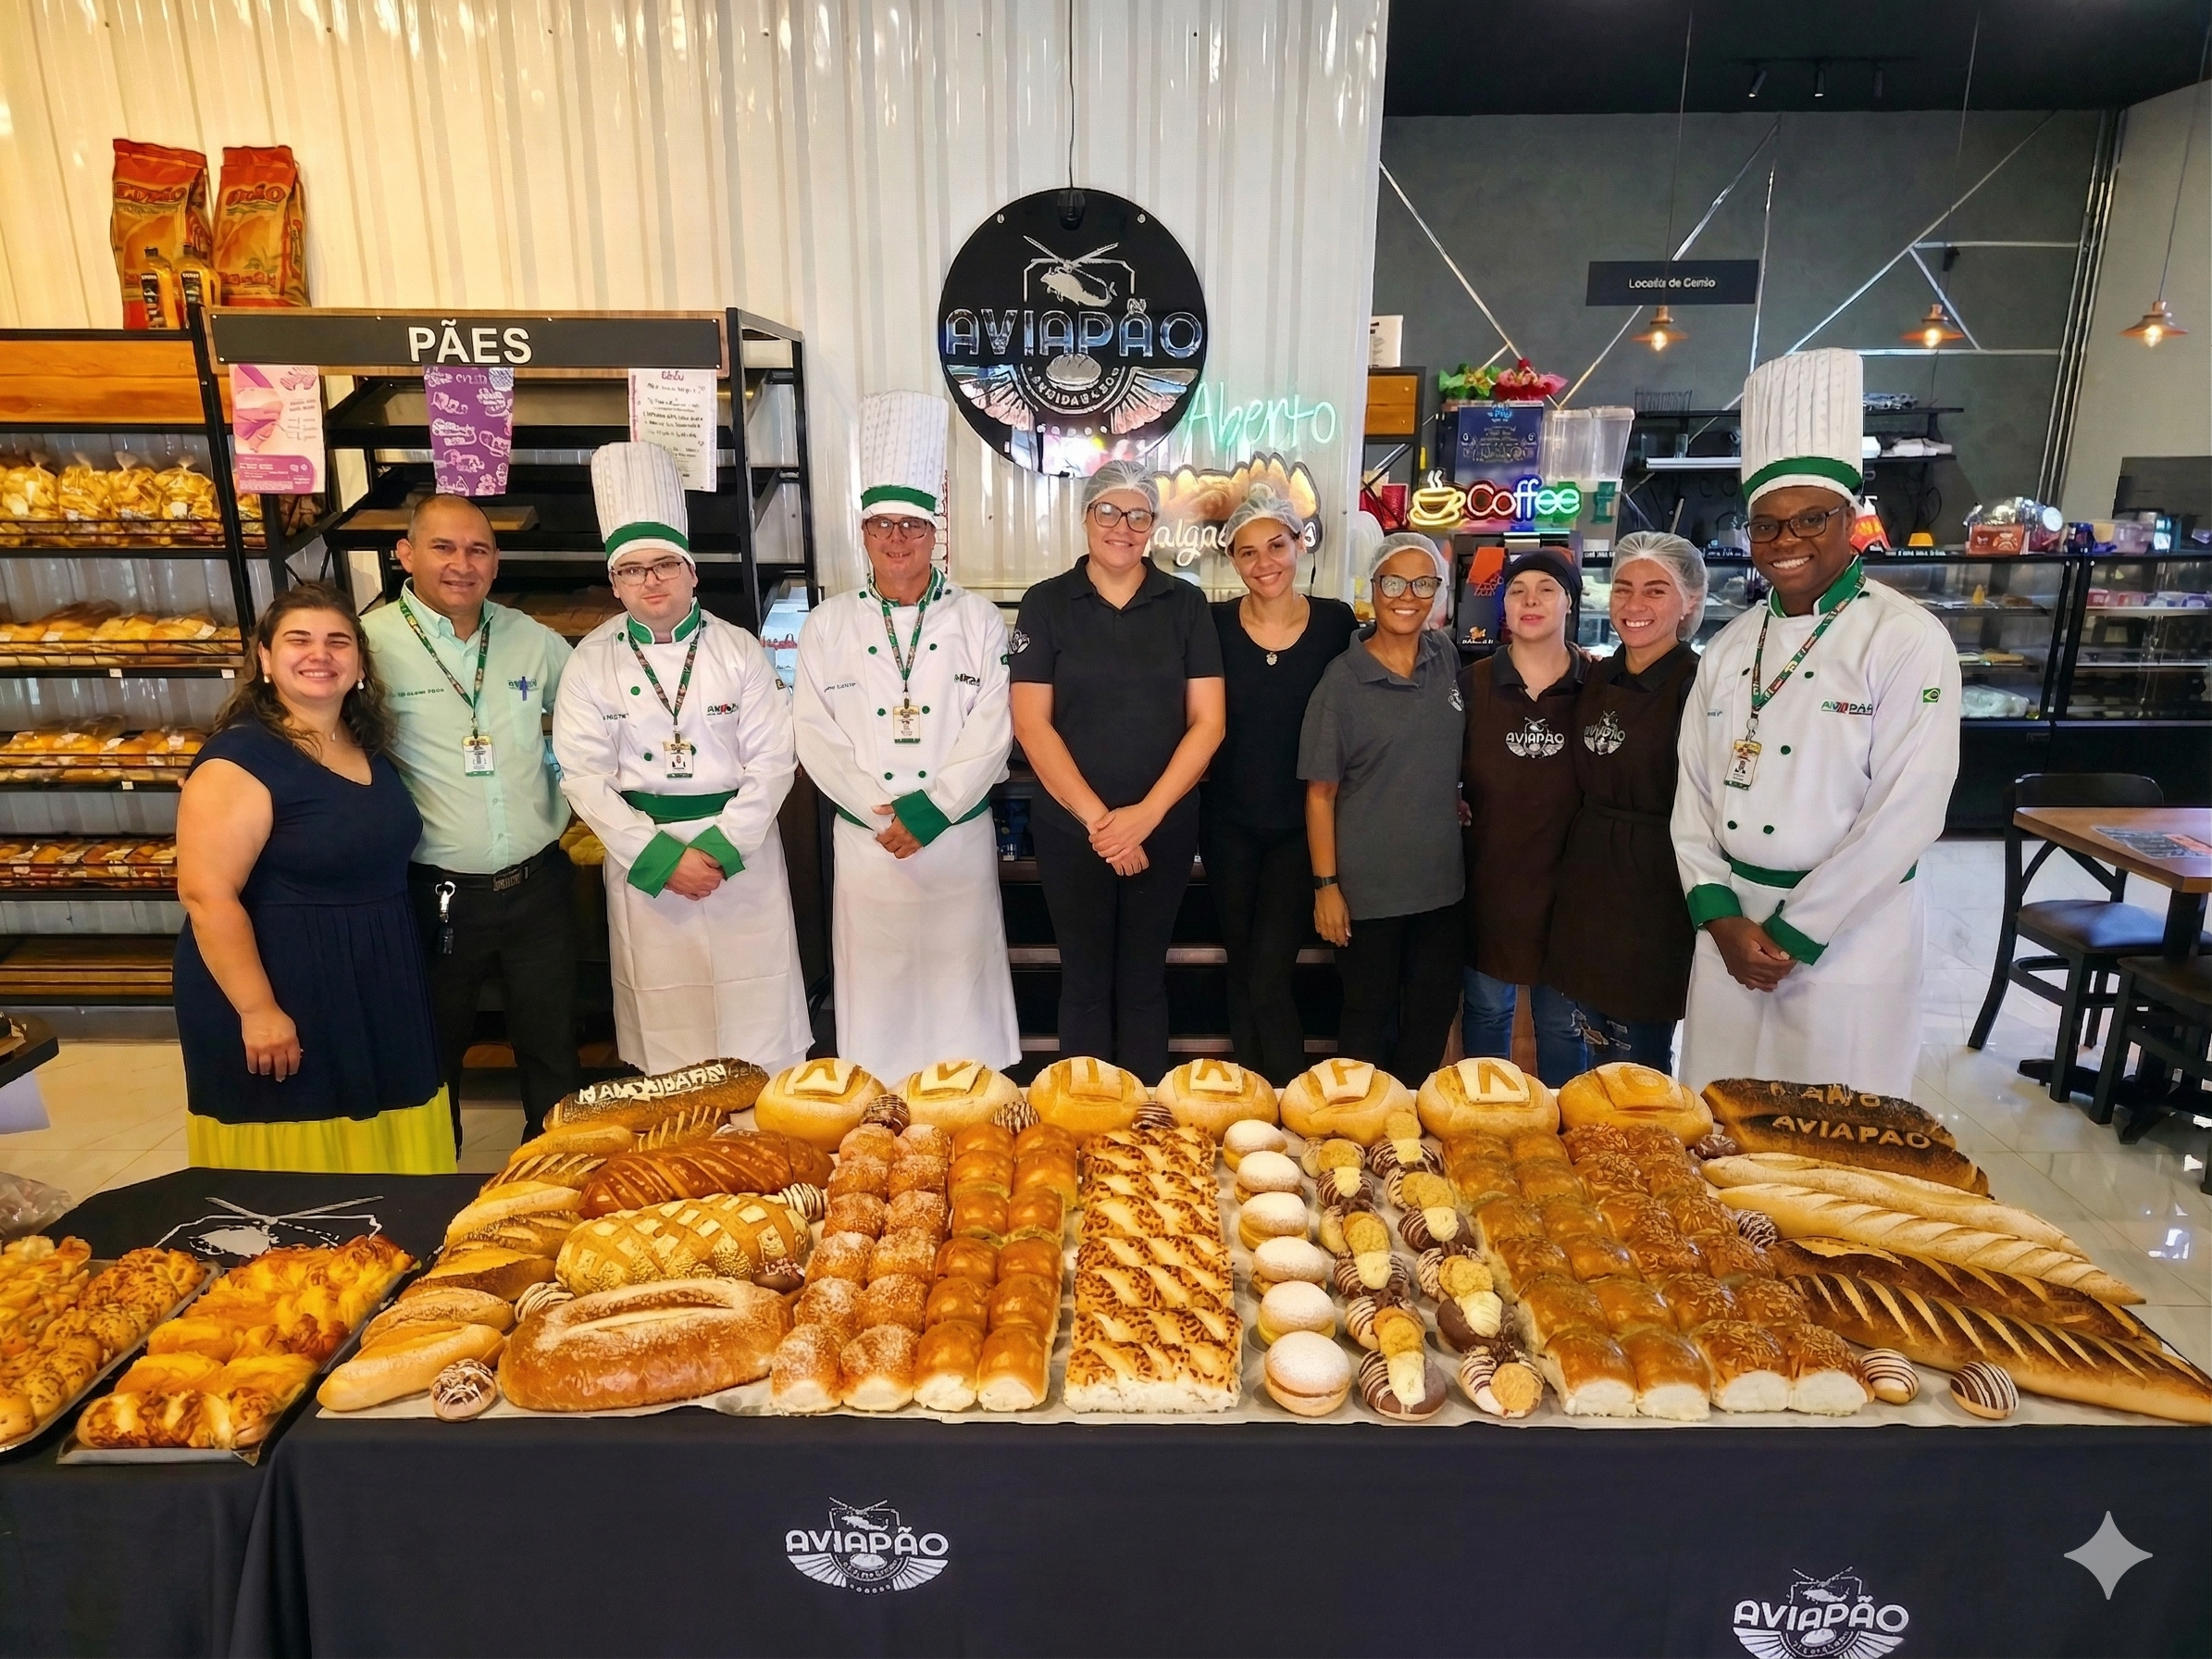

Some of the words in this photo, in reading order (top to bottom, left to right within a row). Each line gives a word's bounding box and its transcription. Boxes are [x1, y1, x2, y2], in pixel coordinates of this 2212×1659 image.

[407, 318, 532, 364] PÃES
[945, 297, 1202, 358] AVIAPÃO
[1180, 380, 1336, 462] Aberto
[1467, 479, 1580, 518] Coffee
[1772, 1115, 1932, 1149] AVIAPAO
[785, 1527, 950, 1557] AVIAPÃO
[1733, 1595, 1909, 1633] AVIAPÃO
